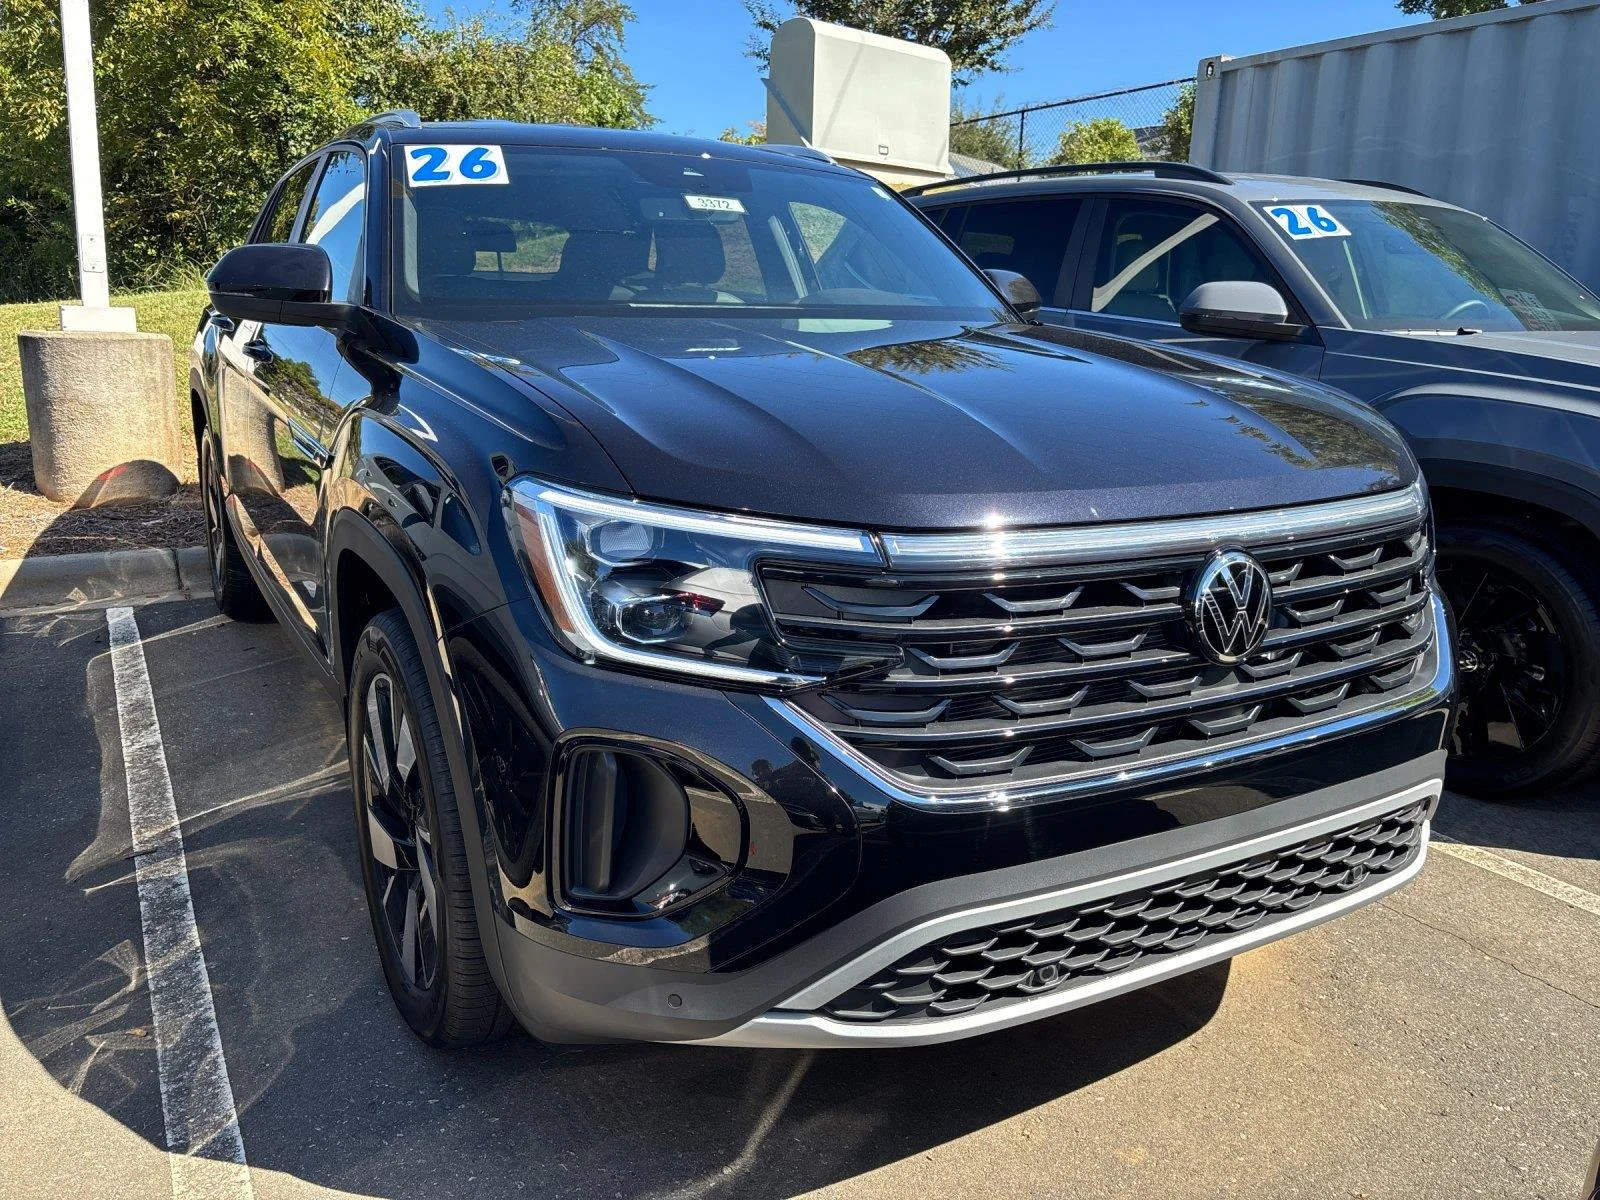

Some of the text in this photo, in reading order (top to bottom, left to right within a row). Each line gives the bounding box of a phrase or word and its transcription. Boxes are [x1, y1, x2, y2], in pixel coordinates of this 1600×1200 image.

[410, 147, 499, 182] 26
[697, 198, 733, 210] 3372
[1270, 206, 1338, 236] 26
